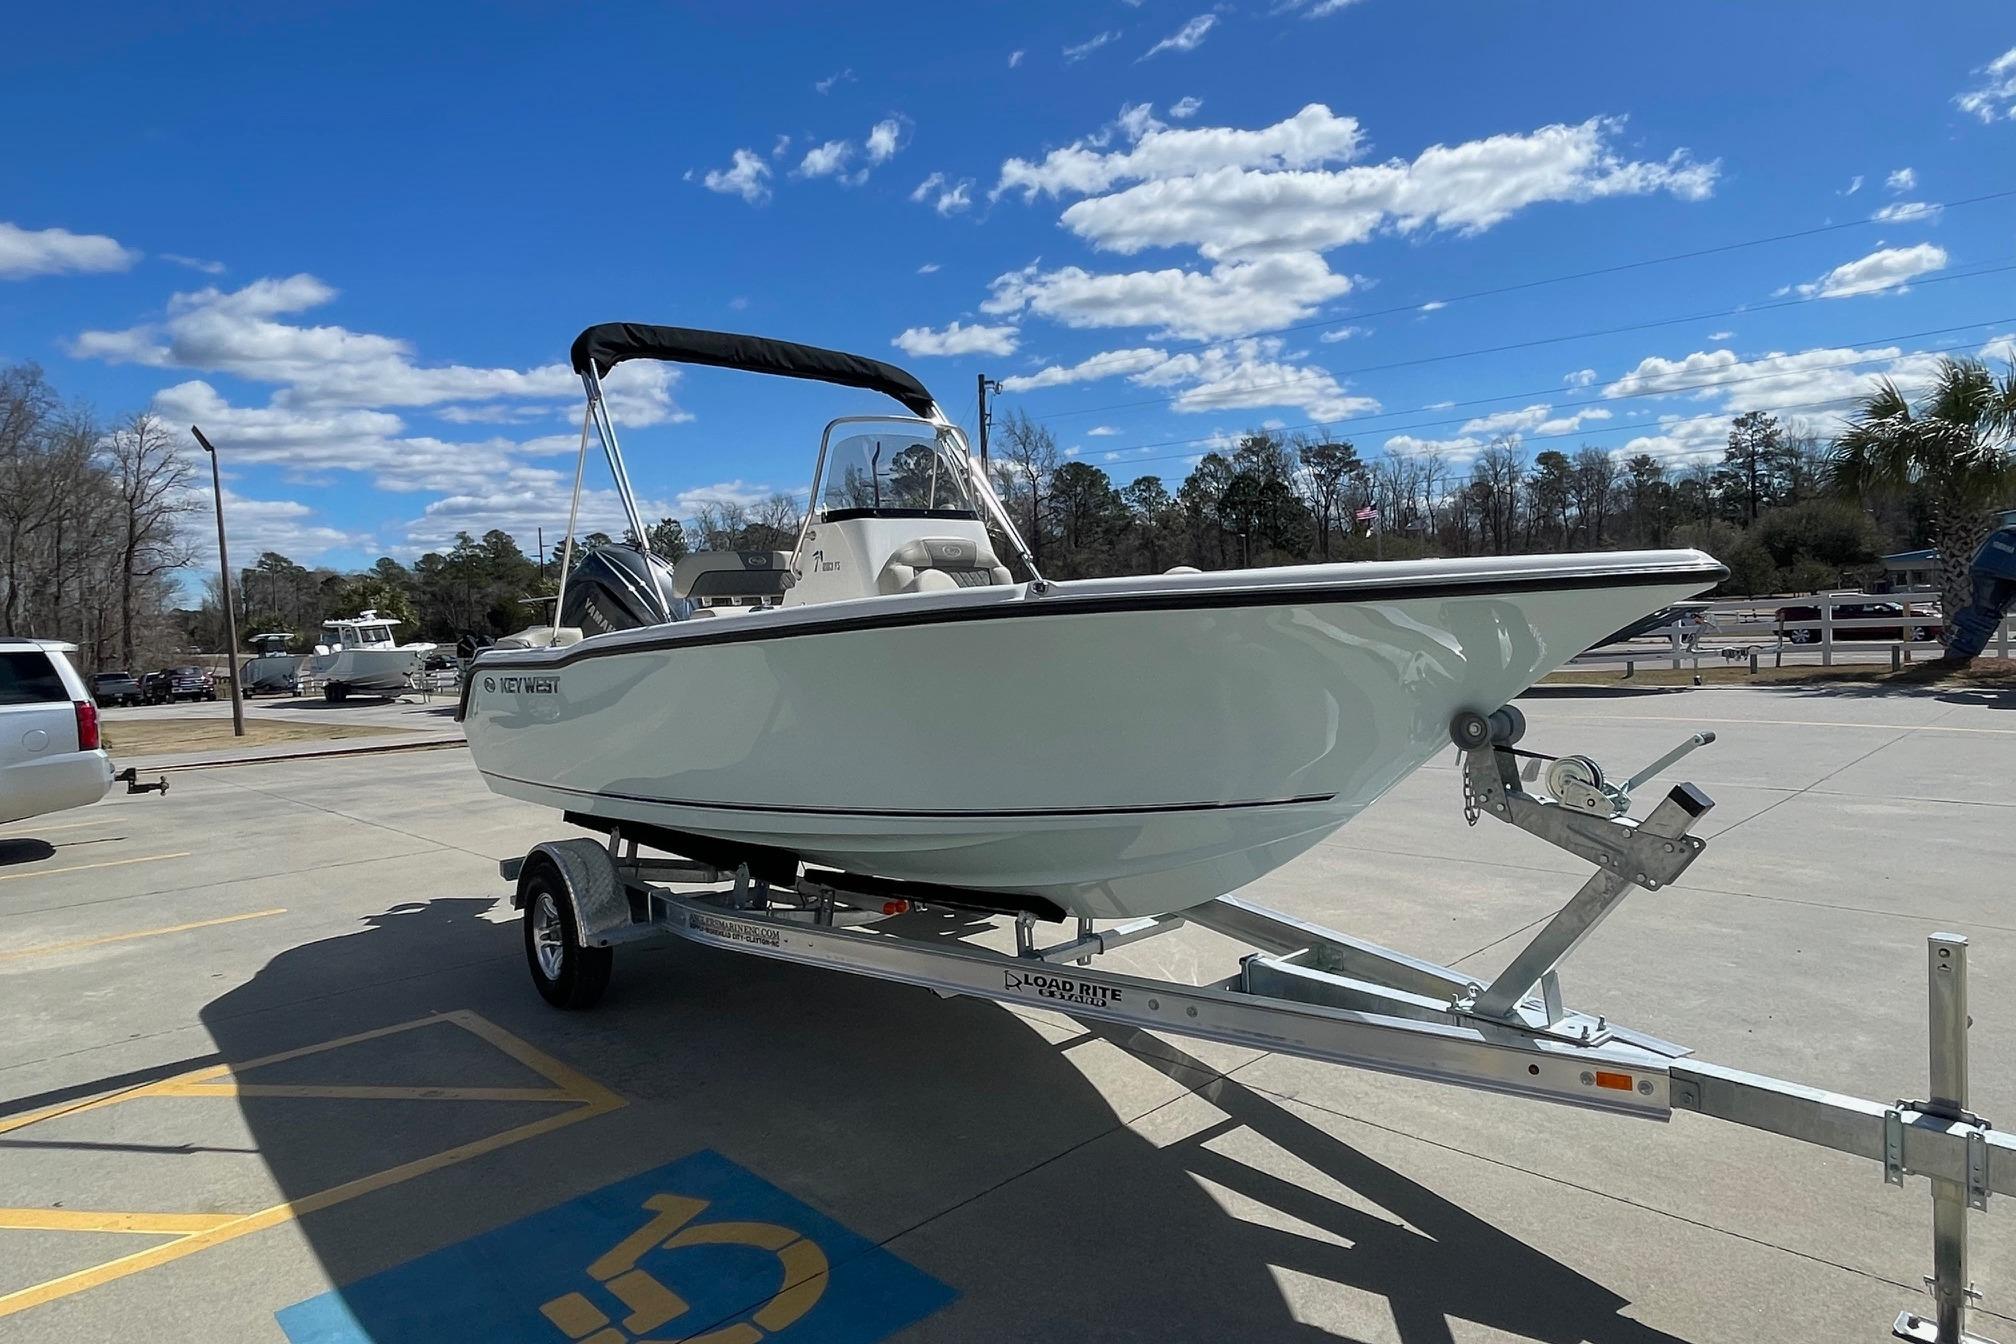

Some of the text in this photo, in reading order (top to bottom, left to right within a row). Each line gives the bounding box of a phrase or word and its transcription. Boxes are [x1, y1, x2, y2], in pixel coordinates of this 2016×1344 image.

[584, 597, 617, 633] YAMAH
[1023, 973, 1123, 1002] LOAD RITE
